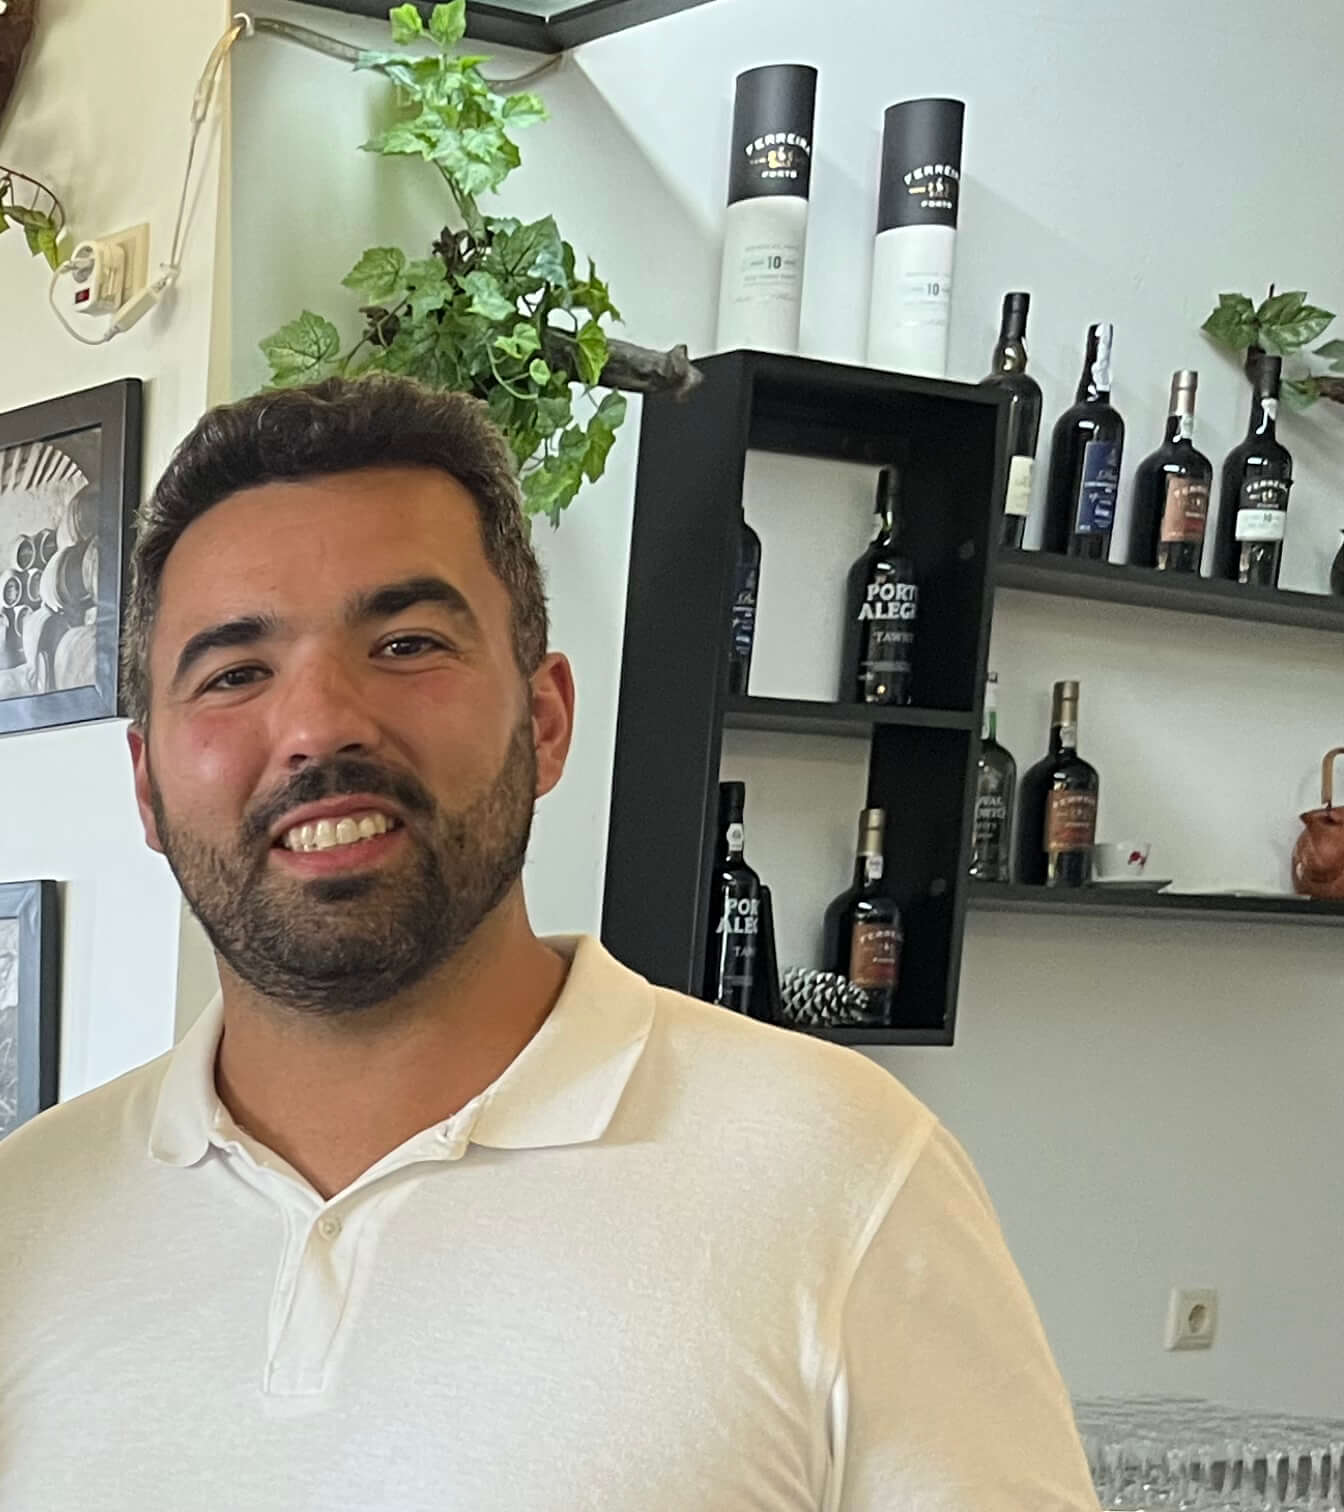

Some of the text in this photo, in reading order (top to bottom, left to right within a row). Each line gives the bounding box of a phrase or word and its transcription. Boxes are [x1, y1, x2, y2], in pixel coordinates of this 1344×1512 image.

[767, 255, 782, 270] 10
[927, 282, 940, 297] 10
[866, 583, 918, 601] PORT
[857, 601, 916, 620] ALEG
